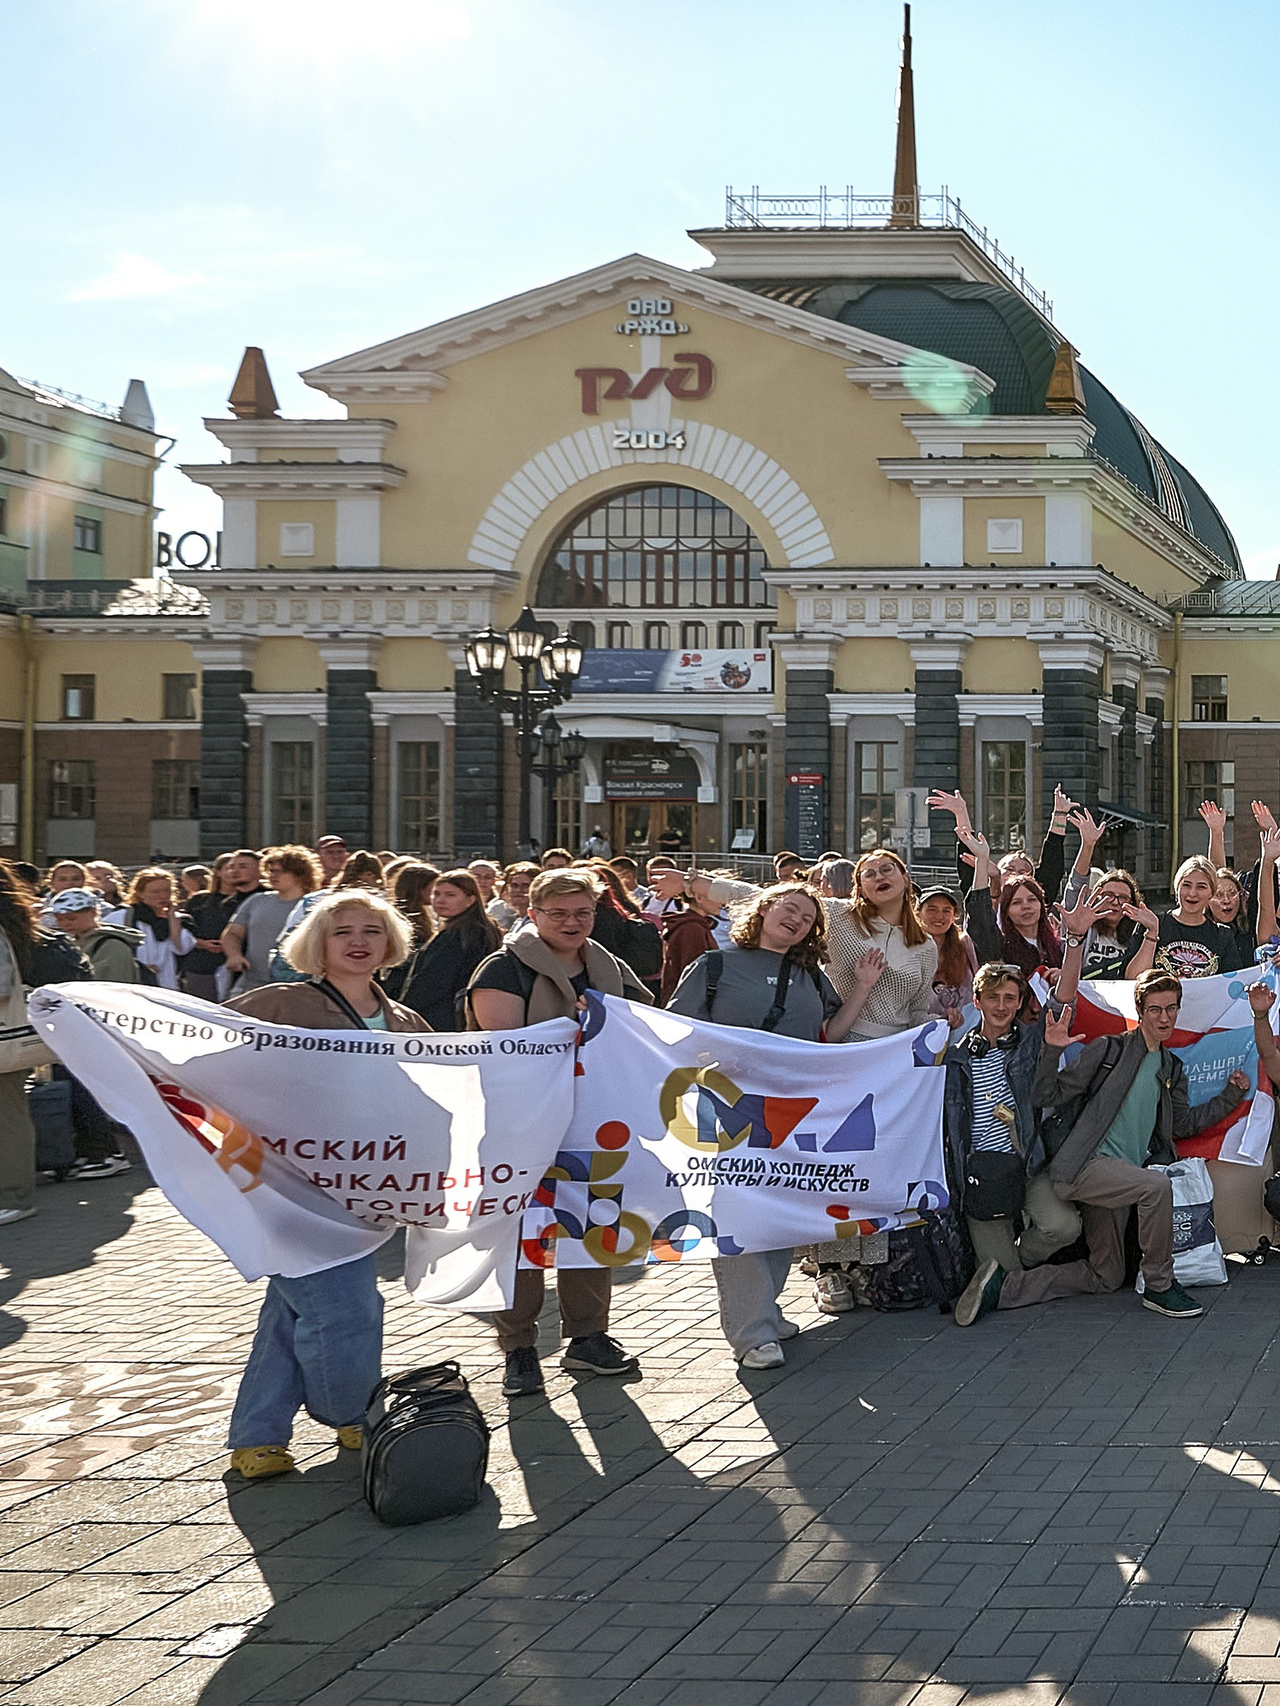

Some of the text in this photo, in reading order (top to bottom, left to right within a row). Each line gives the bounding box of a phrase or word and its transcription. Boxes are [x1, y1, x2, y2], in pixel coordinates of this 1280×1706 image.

[612, 428, 685, 450] 2004
[224, 1026, 396, 1056] образования
[404, 1038, 494, 1057] Омской
[309, 1163, 528, 1192] ЫКАЛЬНО-
[687, 1156, 856, 1179] ОМСКИЙ КОЛЛЕДЖ
[666, 1172, 870, 1192] КУЛЬТУРЫ И ИСКУССТВ
[346, 1188, 537, 1217] ГОГИЧЕСК
